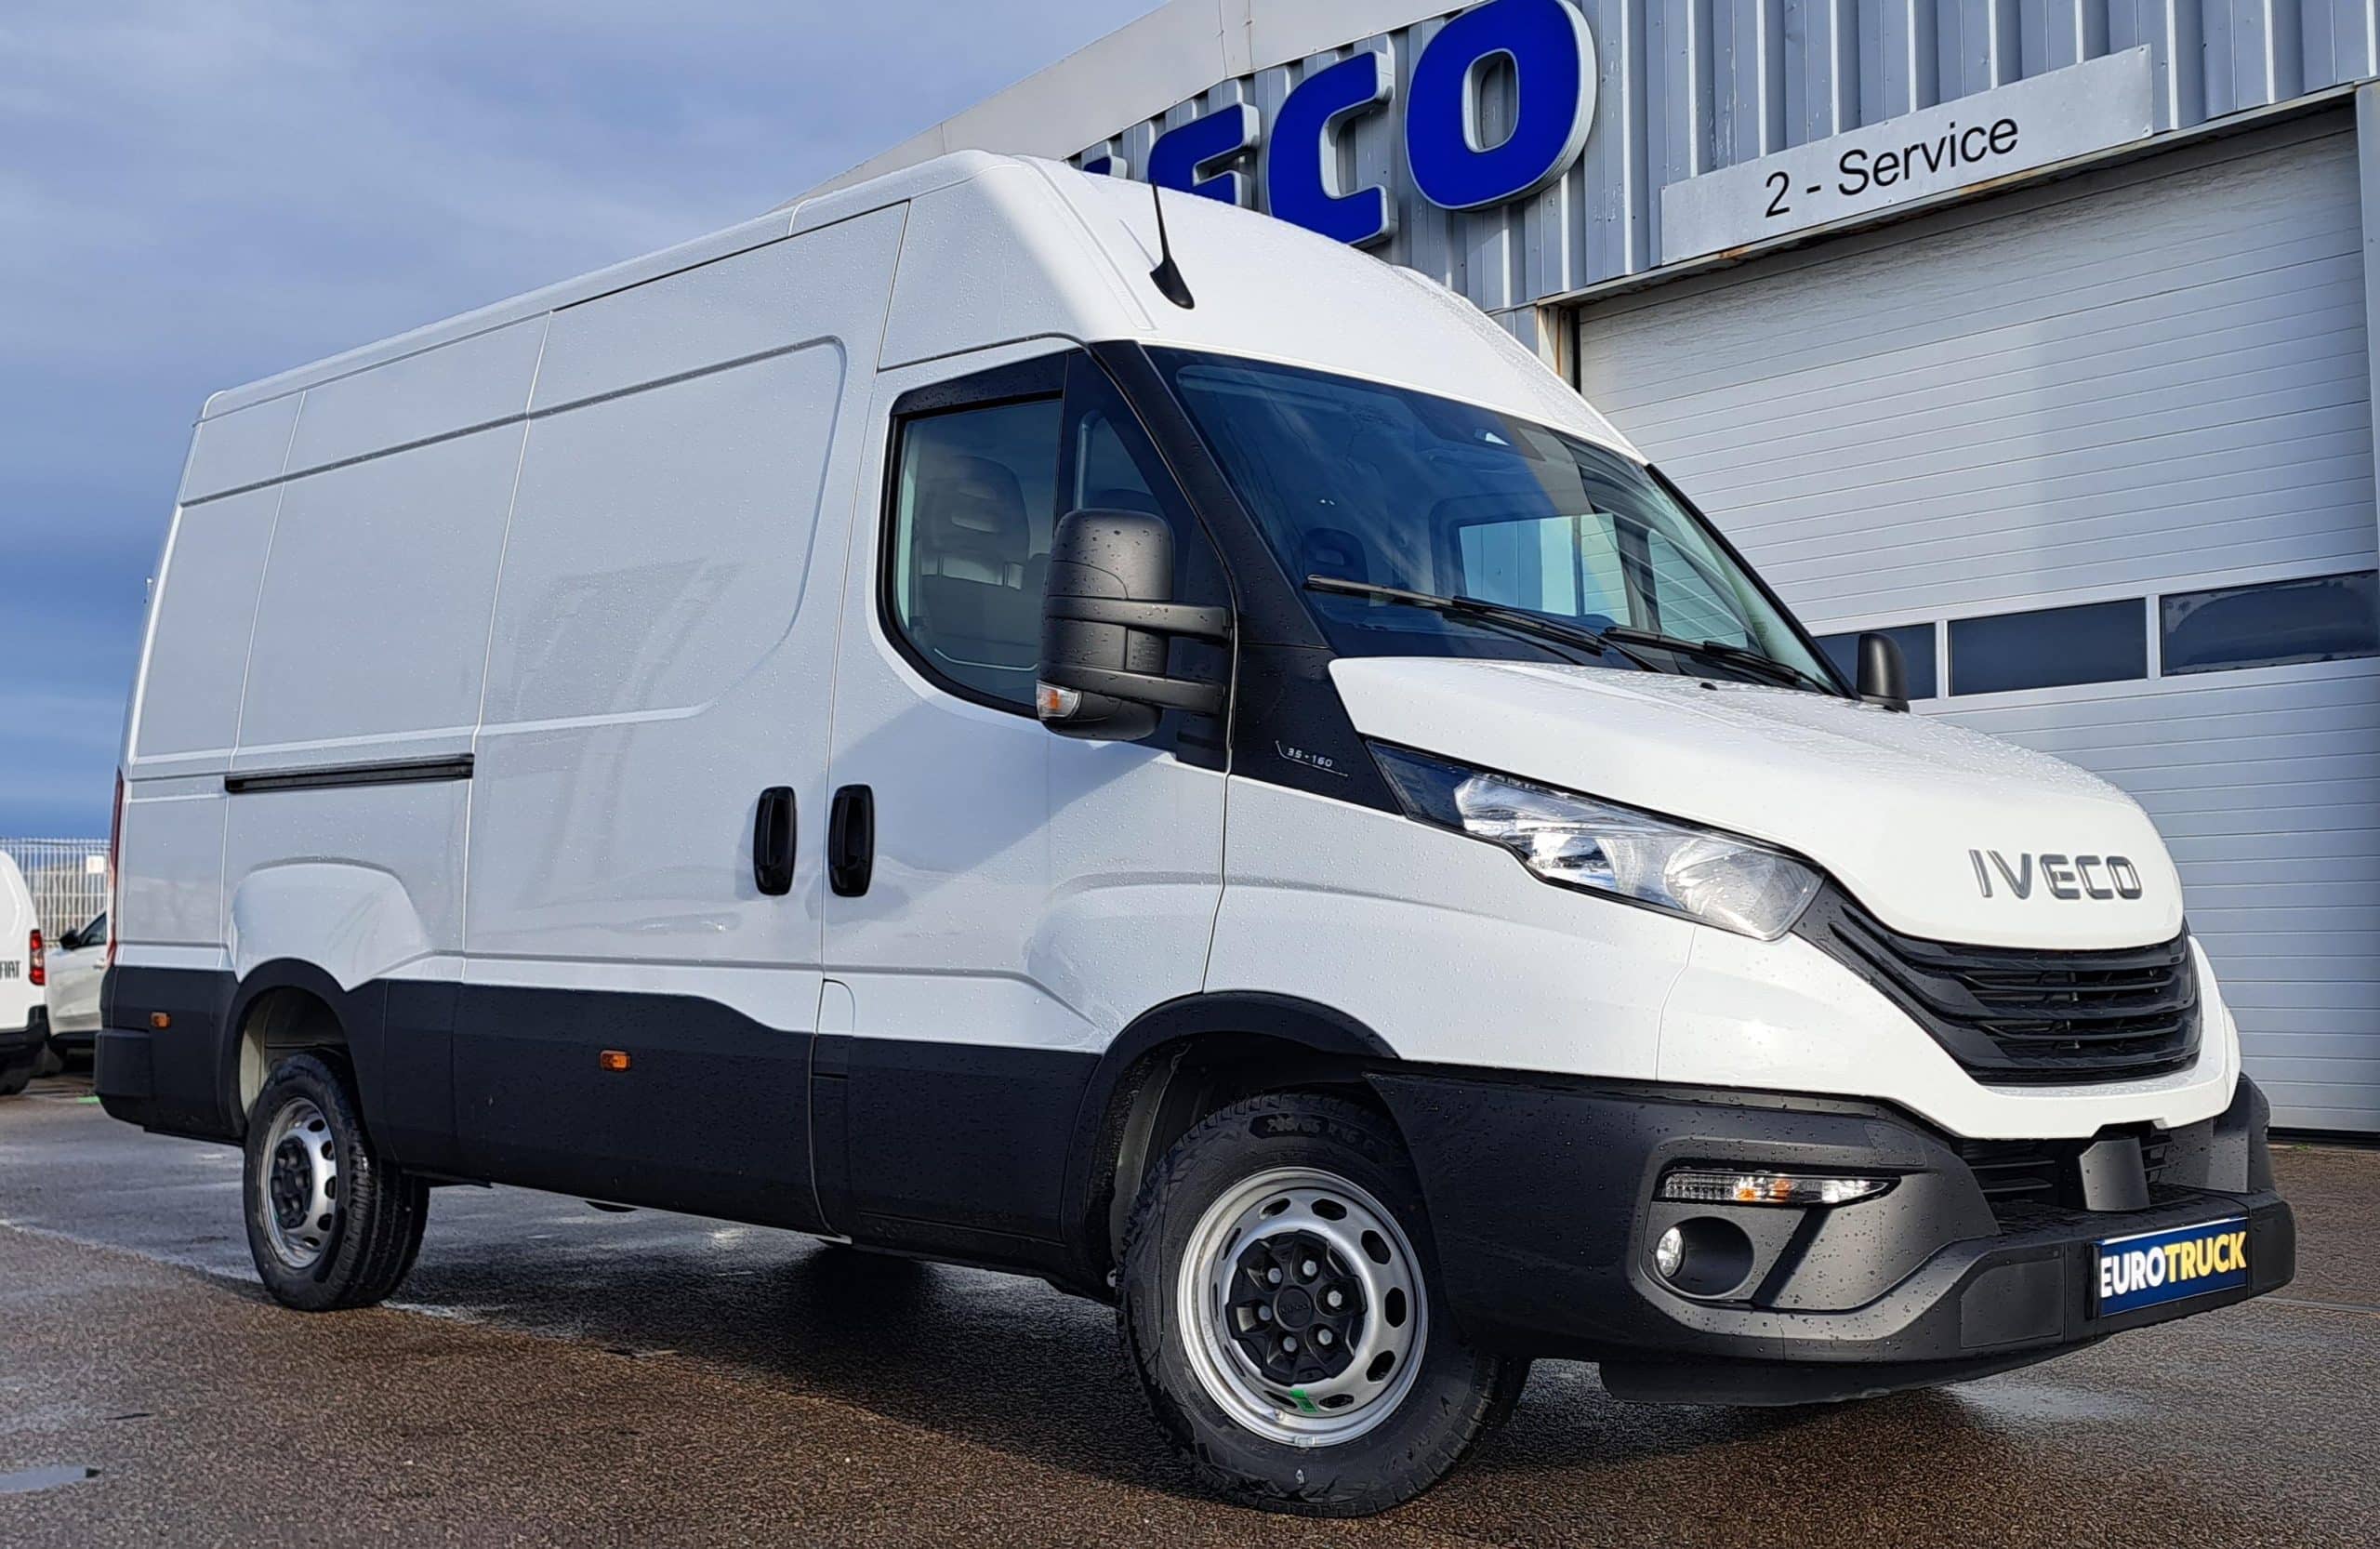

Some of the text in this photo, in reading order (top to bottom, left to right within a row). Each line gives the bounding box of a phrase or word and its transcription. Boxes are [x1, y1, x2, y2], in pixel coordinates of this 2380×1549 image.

[1765, 118, 2018, 218] 2 - Service
[1968, 849, 2143, 900] IVECO
[2099, 1231, 2247, 1299] EUROTRUCK
